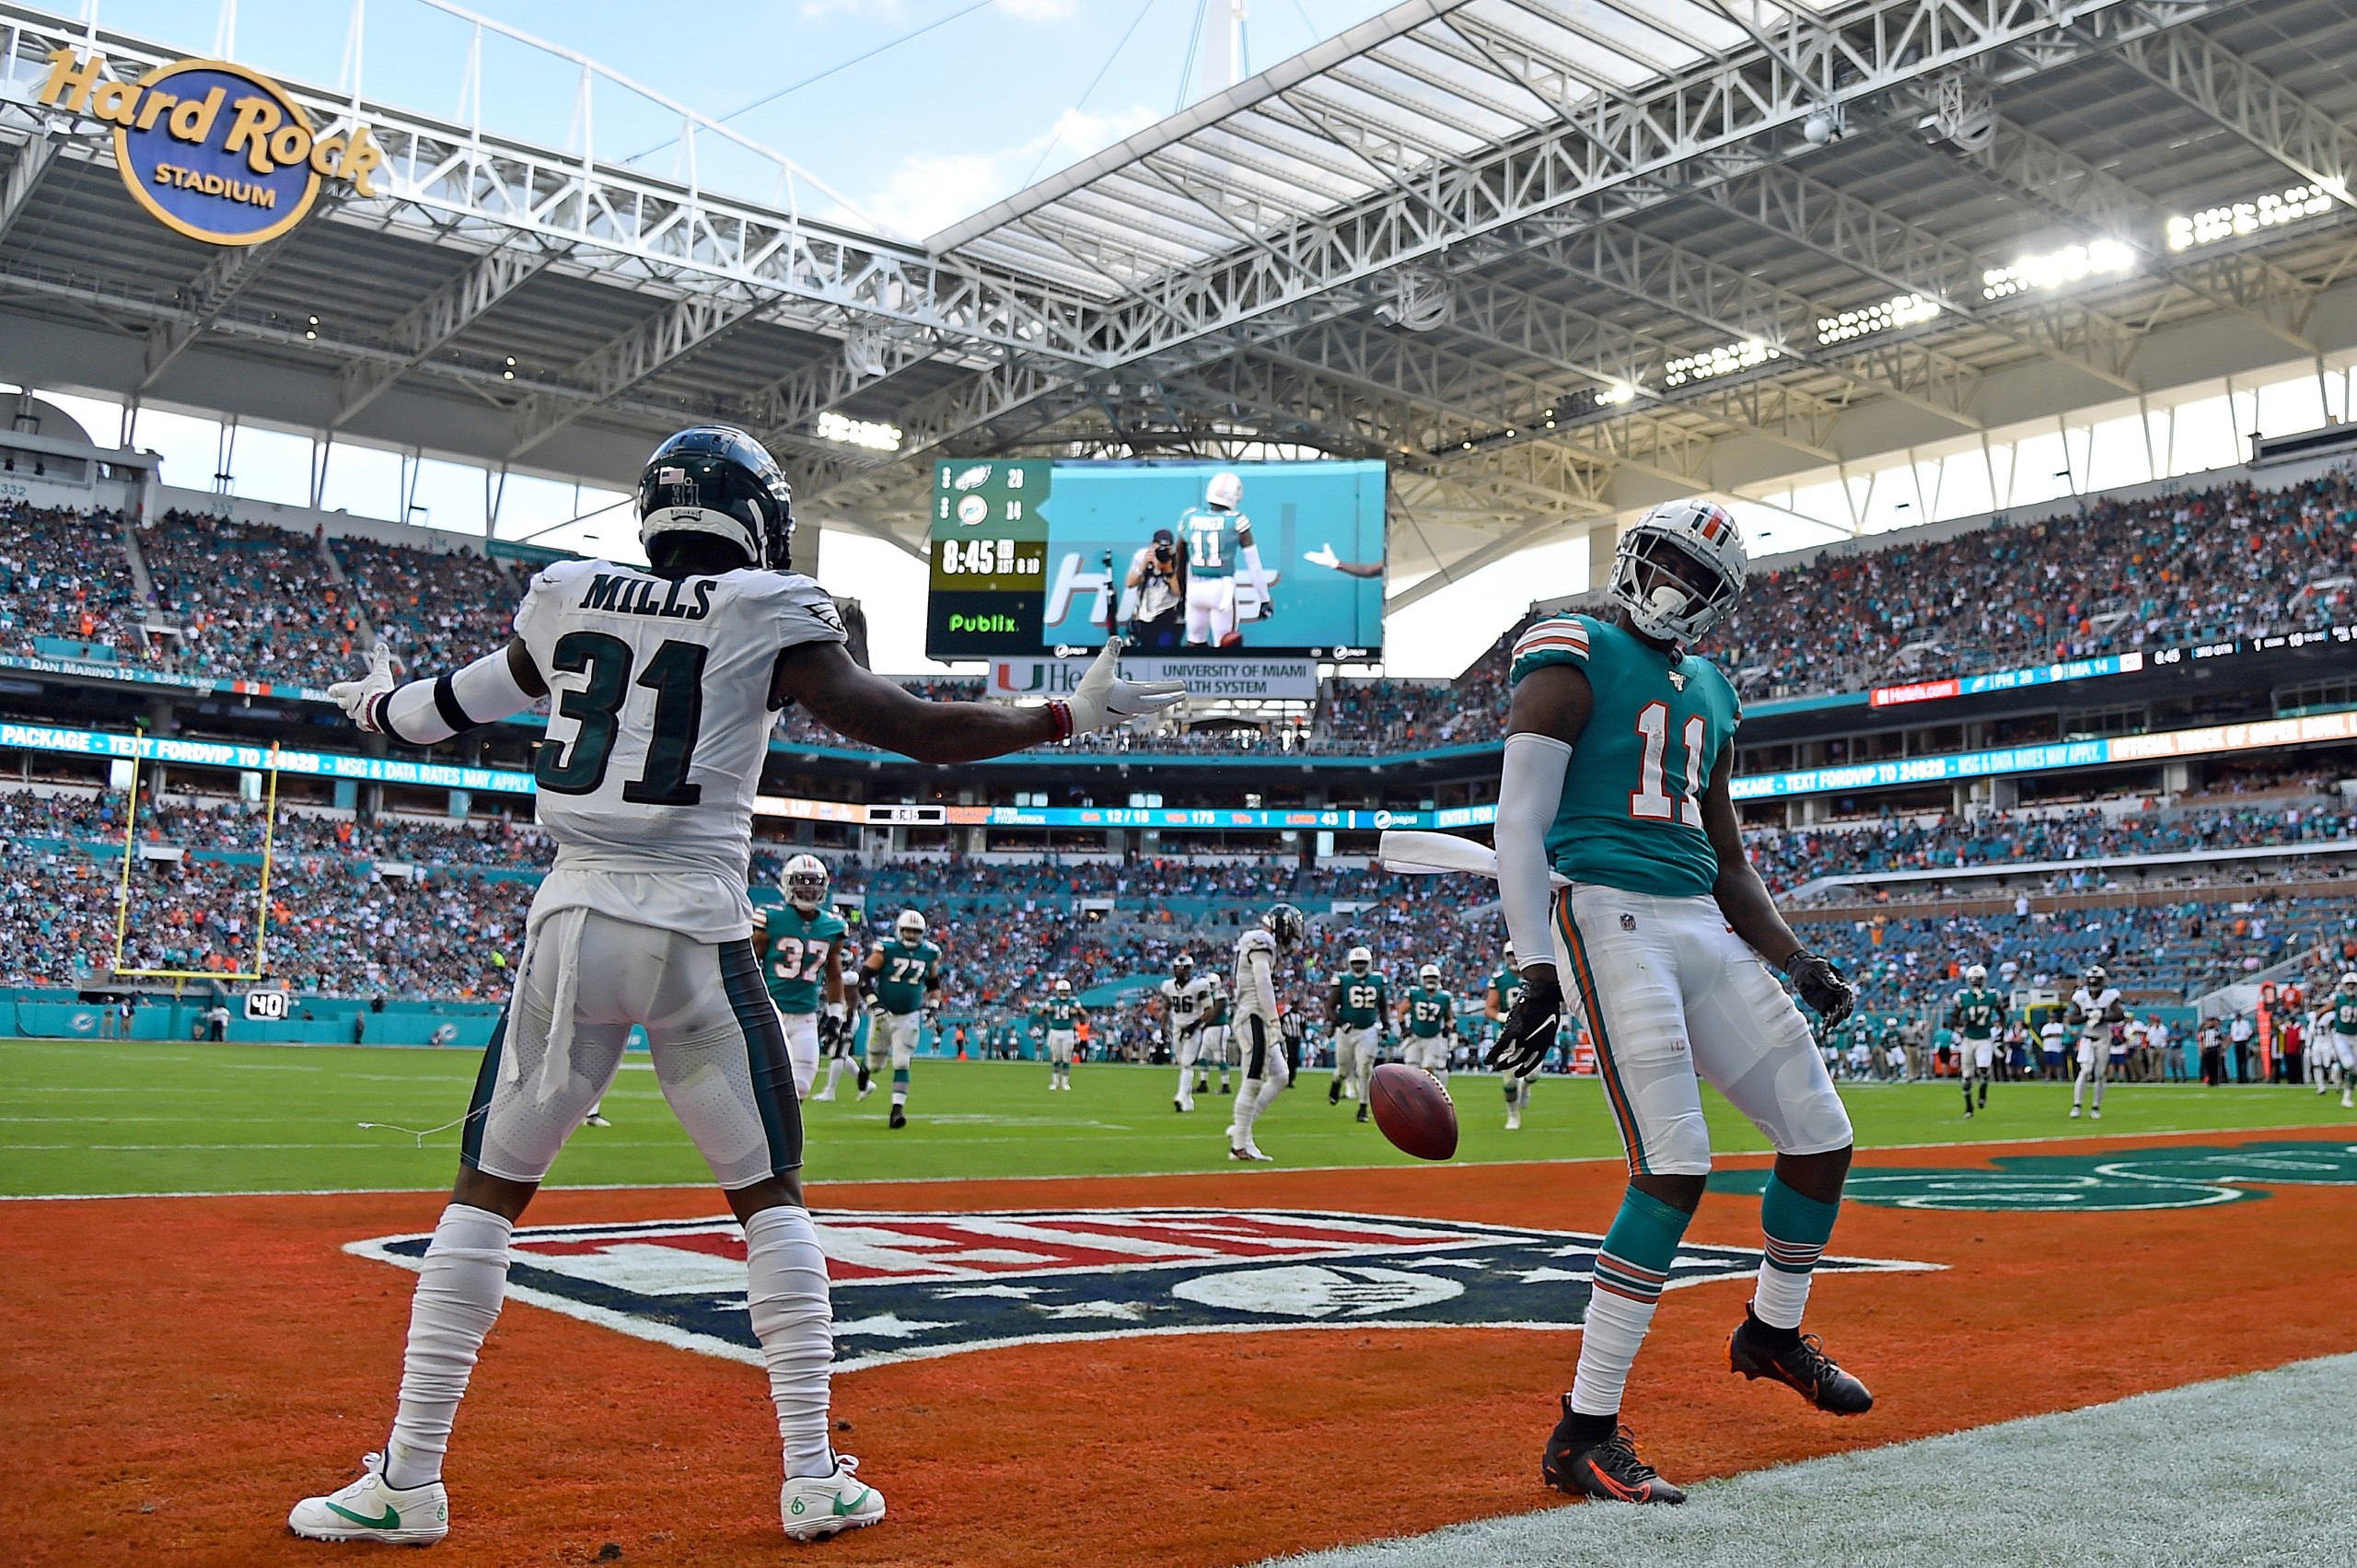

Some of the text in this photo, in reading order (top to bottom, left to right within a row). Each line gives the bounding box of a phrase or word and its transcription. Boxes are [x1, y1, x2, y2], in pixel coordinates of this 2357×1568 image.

[39, 48, 381, 198] Hard Rock
[155, 164, 277, 209] STADIUM
[1, 483, 27, 496] 332
[672, 483, 701, 506] 31
[942, 539, 995, 574] 8:45
[1190, 531, 1222, 566] 11
[578, 573, 717, 621] MILLS
[949, 613, 1016, 633] Publix
[30, 658, 59, 672] DAN
[64, 662, 115, 679] MARINO
[119, 668, 134, 680] 13
[1163, 664, 1306, 678] UNIVERSITY OF MIAMI
[1214, 681, 1267, 693] SYSTEM
[536, 631, 709, 807] 31
[2, 726, 90, 751] PACKAGE
[157, 740, 234, 762] FORDVIP
[238, 747, 261, 765] TO
[336, 758, 367, 777] MSG
[372, 761, 382, 778] &
[386, 762, 417, 781] DATA
[422, 766, 461, 785] RATES
[464, 772, 489, 787] MAY
[494, 775, 530, 791] APPLY
[1629, 700, 1706, 829] 11
[1786, 772, 1816, 792] TEXT
[1819, 765, 1876, 789] FORDVIP
[1879, 763, 1897, 783] TO
[1899, 758, 1945, 781] 24928
[1320, 811, 1339, 826] 43
[1391, 813, 1418, 825] pepsi
[1439, 805, 1492, 826] ENTER FOR
[773, 936, 830, 982] 37
[889, 957, 926, 985] 77
[251, 994, 283, 1016] 40
[1172, 995, 1193, 1014] 96
[1349, 985, 1377, 1009] 62
[1414, 1001, 1441, 1022] 67
[1968, 1005, 1989, 1026] 17
